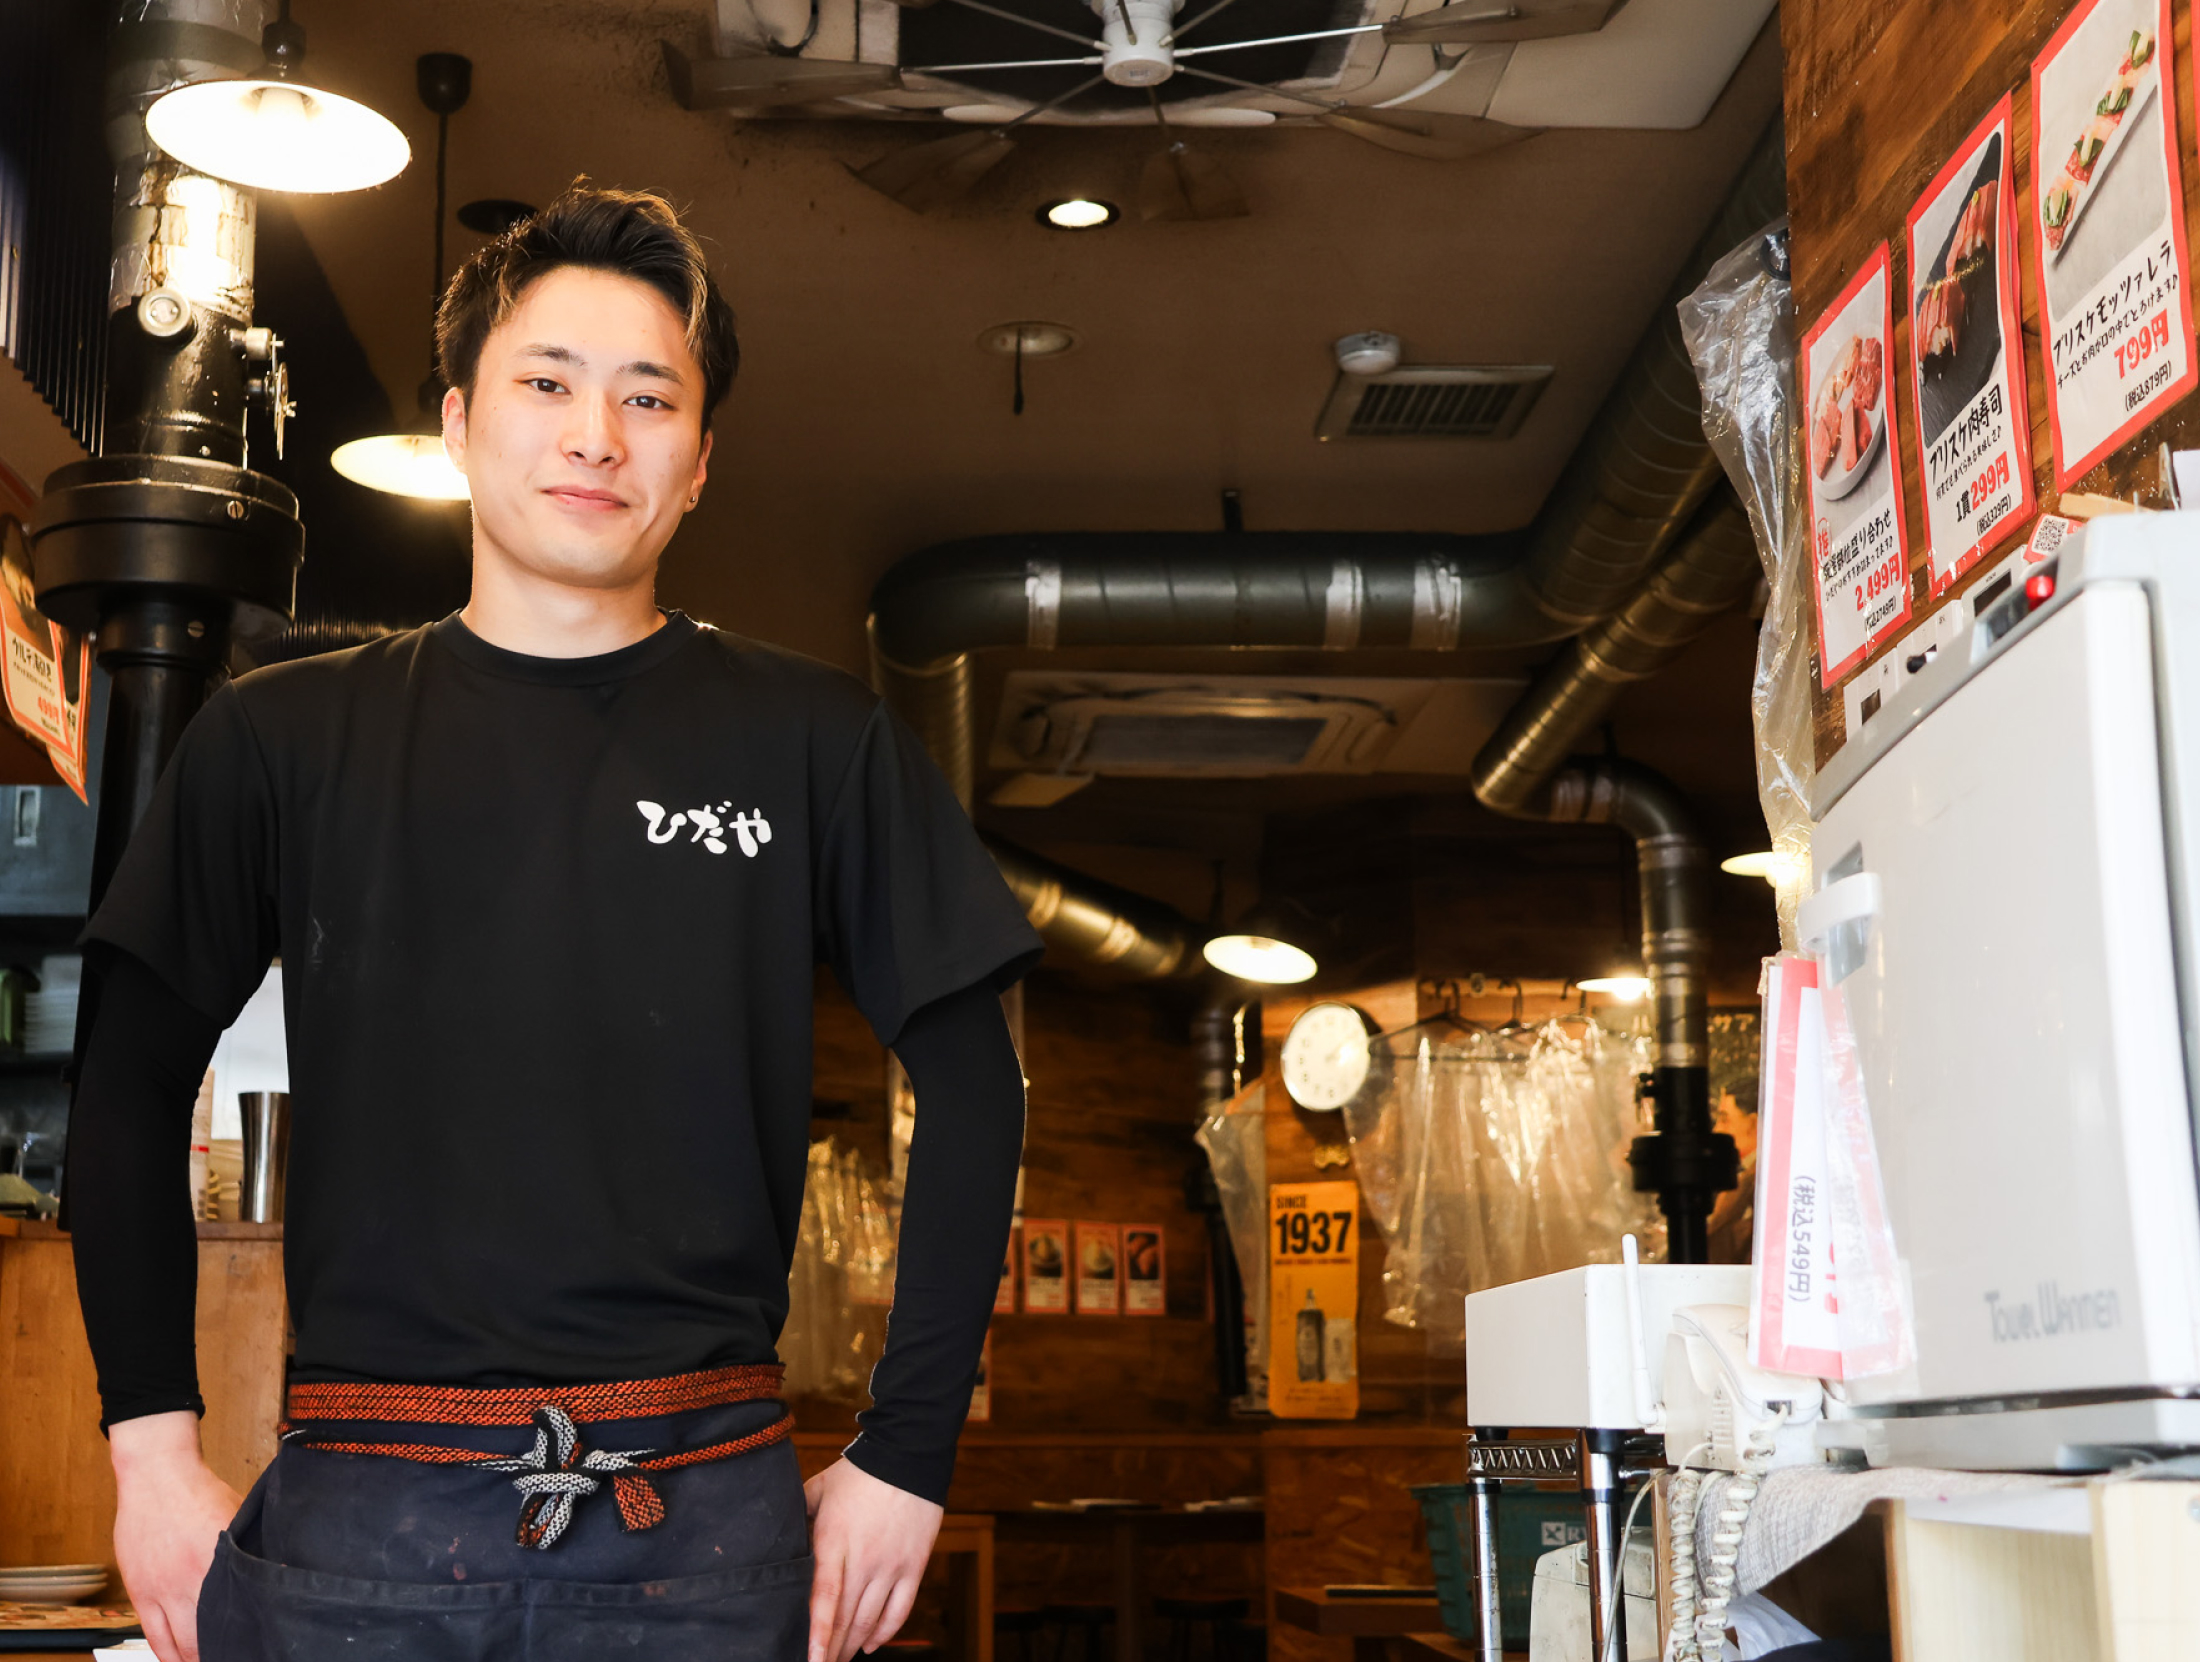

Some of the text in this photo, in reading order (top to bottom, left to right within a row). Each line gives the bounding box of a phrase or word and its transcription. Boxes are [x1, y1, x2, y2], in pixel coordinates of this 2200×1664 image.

[2053, 240, 2171, 367] ブリスケモッツァレラ
[2113, 308, 2170, 380] 799円
[1929, 382, 2003, 486] ブリスケ肉寿司
[636, 800, 773, 858] ひだや
[1275, 1210, 1352, 1255] 1937
[1276, 1195, 1307, 1210] SINCE
[1787, 1175, 1817, 1302] (税込549円)
